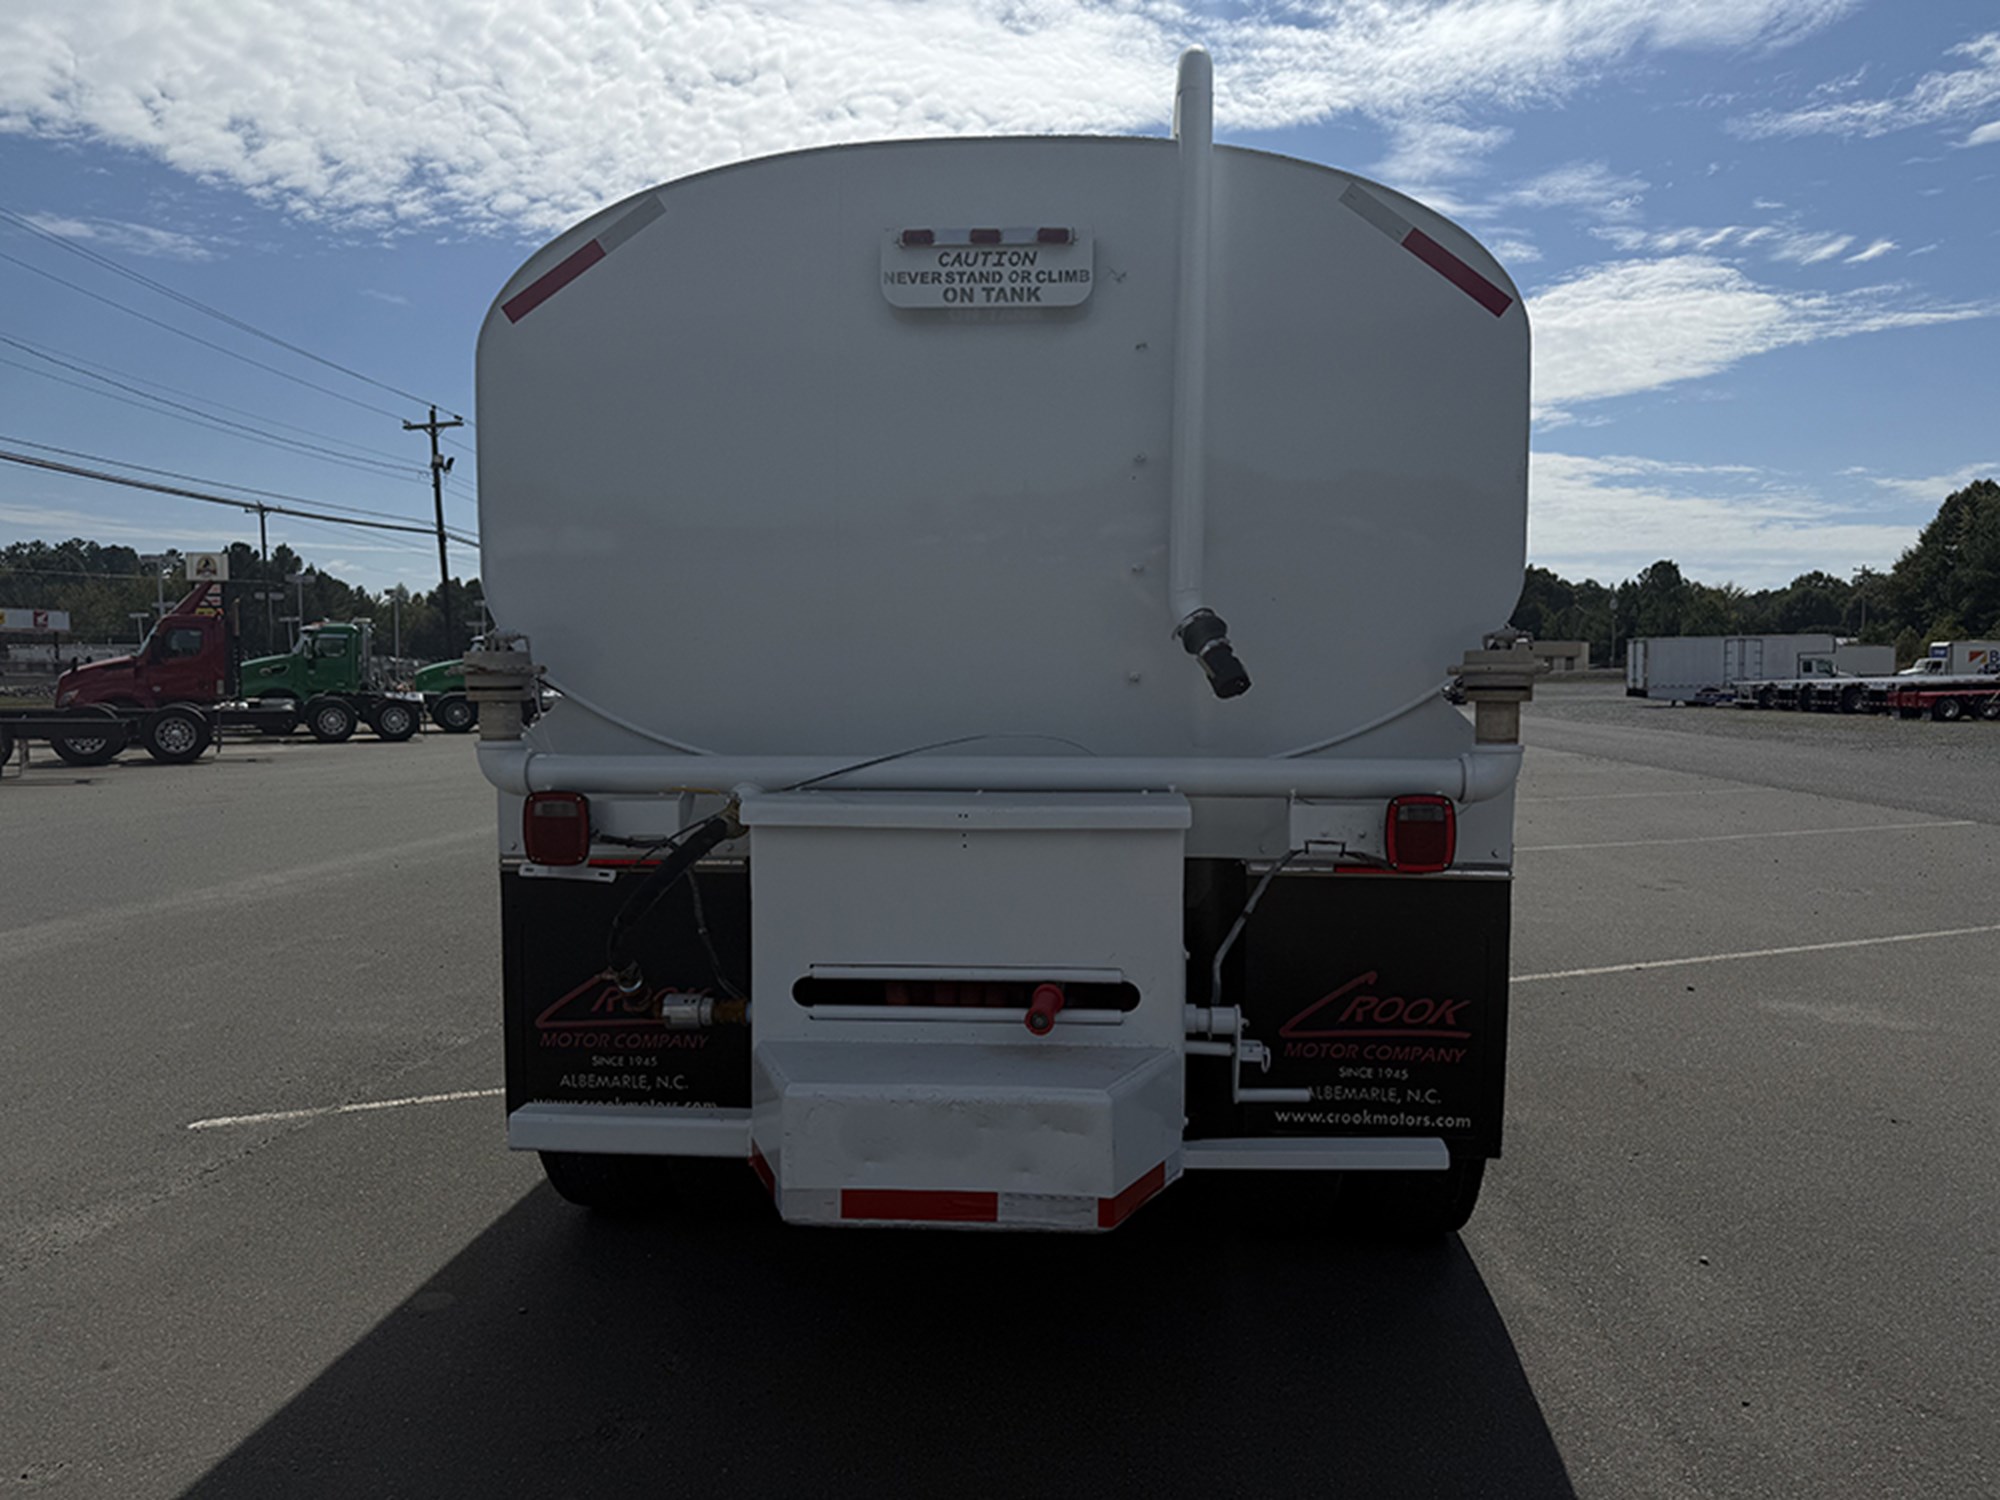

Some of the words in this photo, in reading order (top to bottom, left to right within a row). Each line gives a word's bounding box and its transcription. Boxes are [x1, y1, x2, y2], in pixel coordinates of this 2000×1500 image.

[938, 251, 1038, 267] CAUTION
[884, 271, 942, 285] NEVER
[945, 271, 1001, 284] STAND
[1008, 270, 1034, 284] OR
[1035, 269, 1090, 284] CLIMB
[942, 287, 974, 303] ON
[981, 286, 1042, 303] TANK
[1279, 970, 1472, 1038] CROOK
[539, 1032, 610, 1048] MOTOR
[614, 1032, 709, 1049] COMPANY
[1283, 1042, 1358, 1059] MOTOR
[1362, 1044, 1467, 1063] COMPANY
[591, 1055, 624, 1068] SINCE
[1338, 1066, 1374, 1080] SINCE
[559, 1074, 652, 1091] ALBEMARLE,
[656, 1075, 689, 1091] N.C.
[1405, 1088, 1442, 1105] N.C.
[1274, 1109, 1472, 1129] www.crookmotors.com
